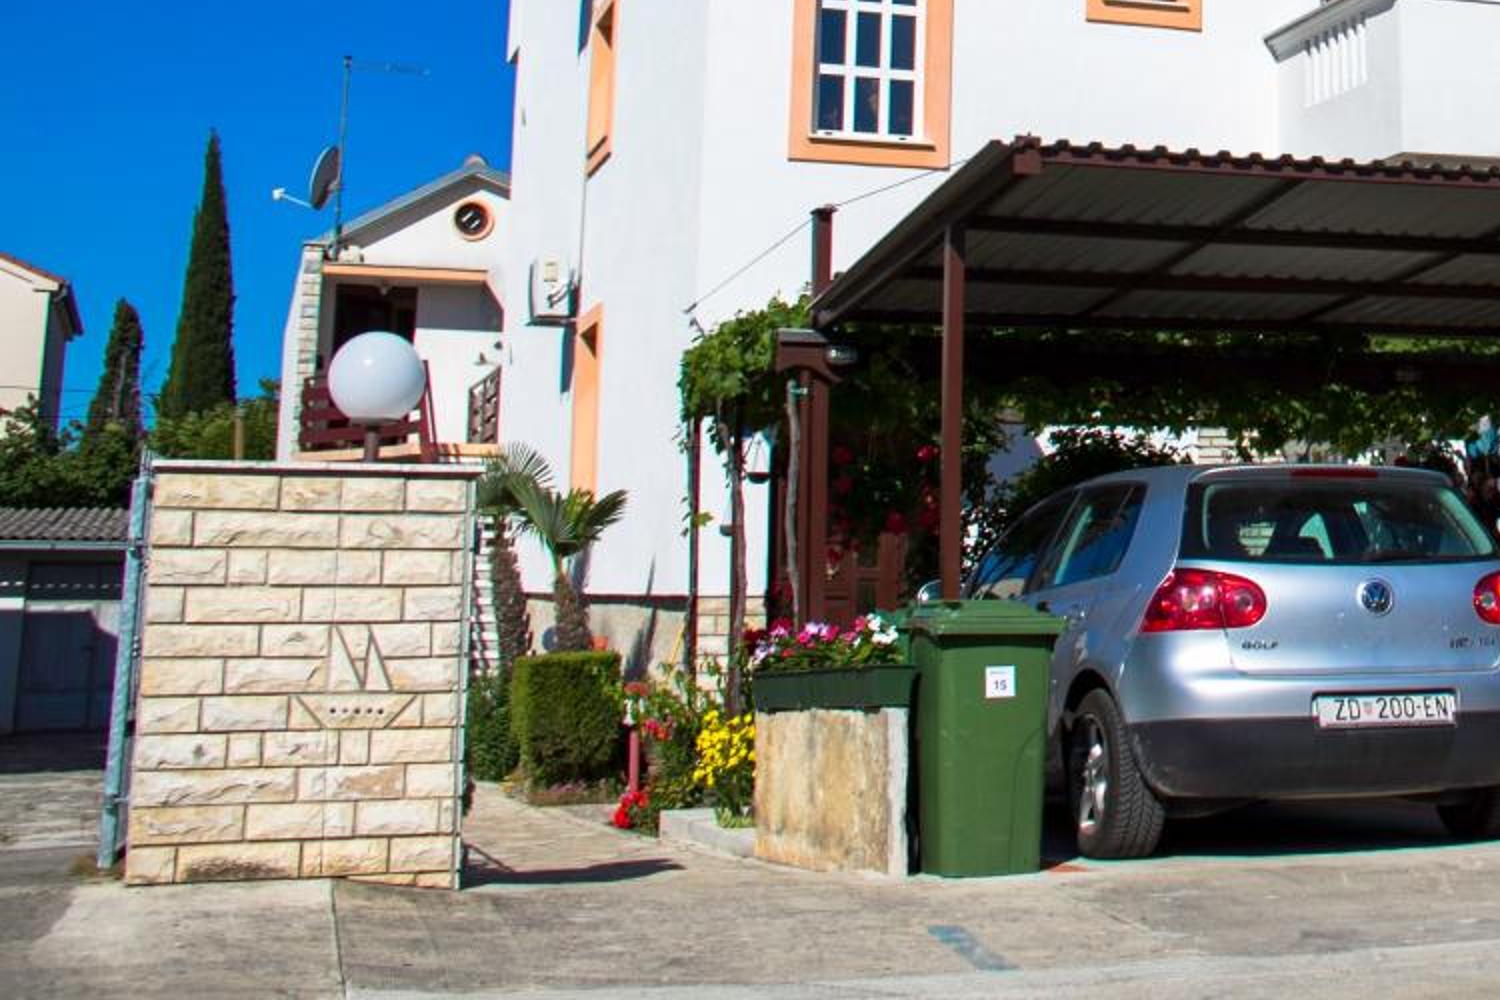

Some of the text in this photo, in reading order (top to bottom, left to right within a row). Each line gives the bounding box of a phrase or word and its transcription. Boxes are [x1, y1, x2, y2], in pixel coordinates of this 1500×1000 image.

[994, 679, 1008, 691] 15
[1333, 696, 1448, 720] ZD 200-EN
